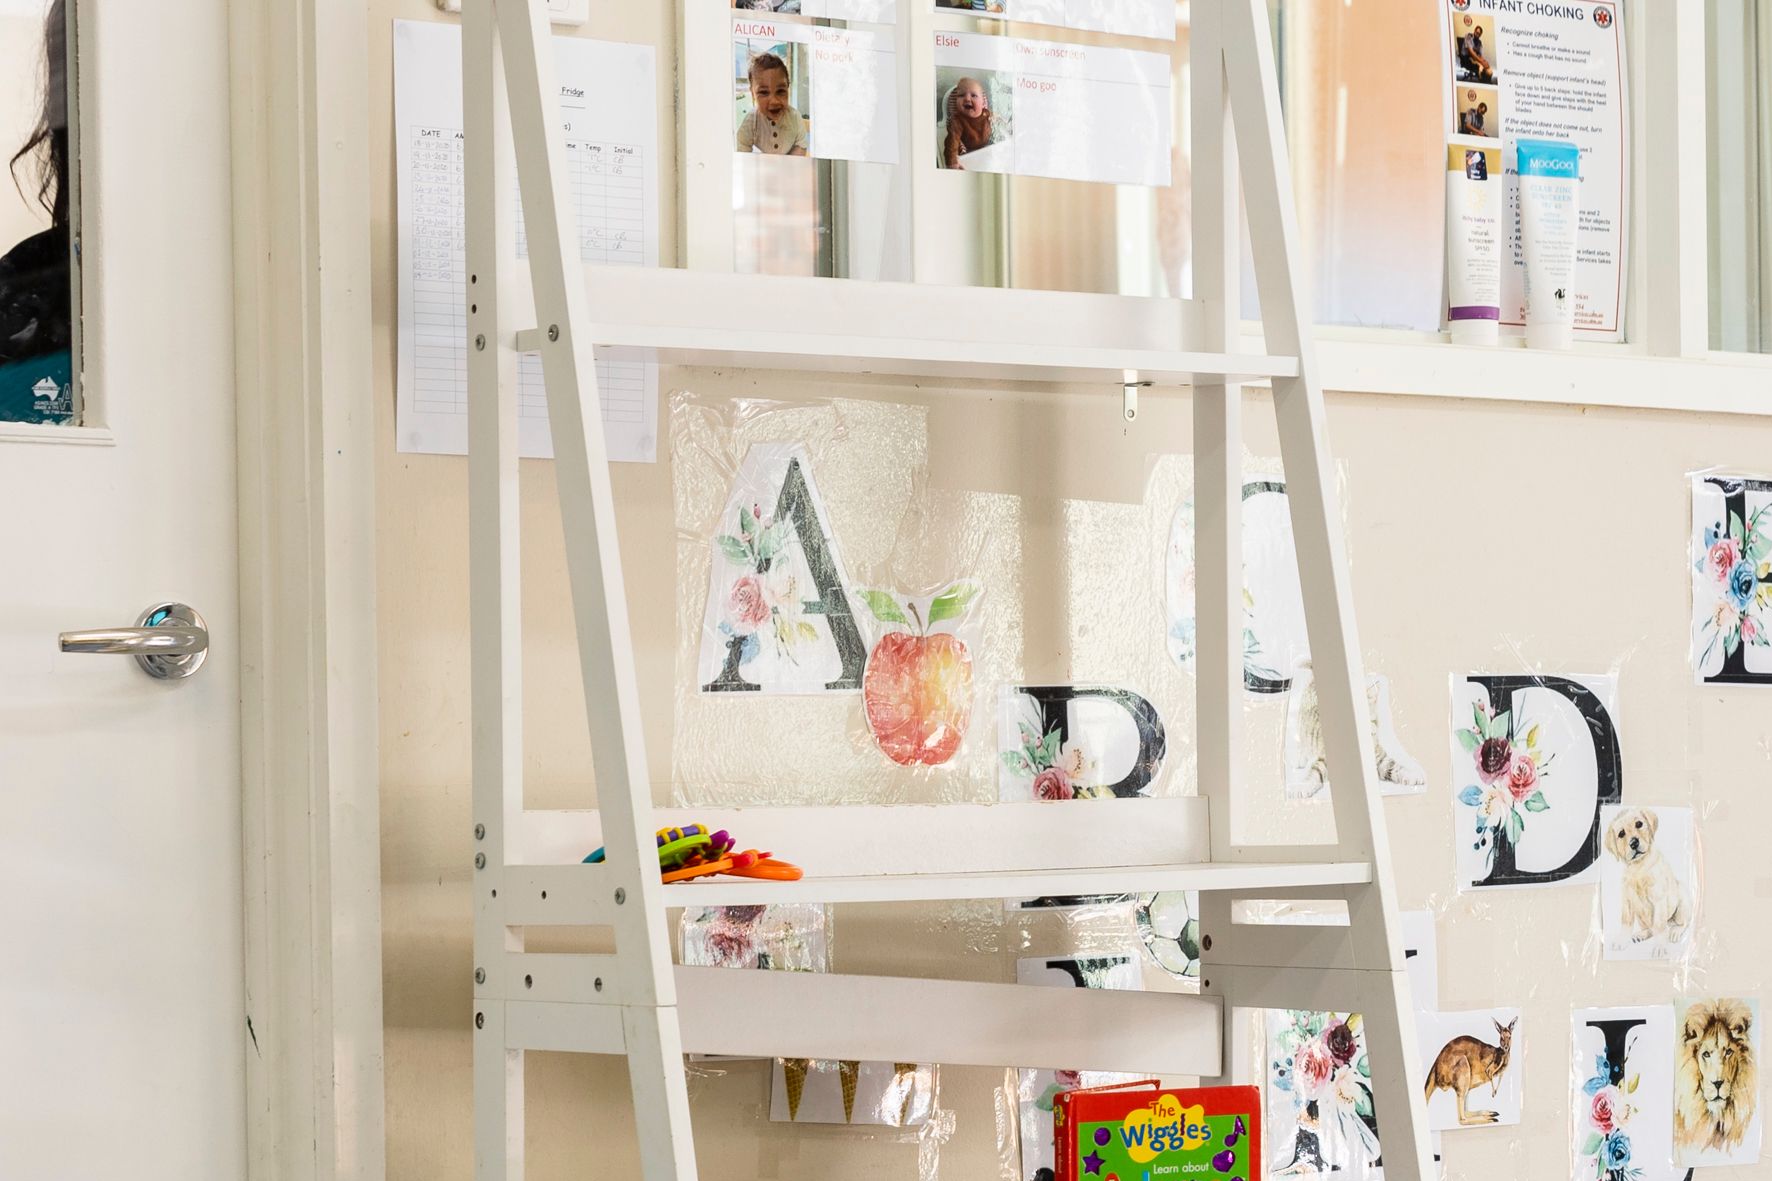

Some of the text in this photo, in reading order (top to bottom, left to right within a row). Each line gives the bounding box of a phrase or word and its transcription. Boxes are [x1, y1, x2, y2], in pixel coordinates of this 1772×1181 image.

[1480, 0, 1584, 20] INFANT CHOKING
[734, 23, 775, 37] ALICAN
[1501, 26, 1559, 41] Recognize choking
[936, 35, 960, 47] Elsie
[561, 85, 585, 98] Fridge
[1040, 80, 1057, 92] goo
[421, 130, 441, 138] DATE
[585, 143, 601, 152] Temp
[614, 146, 633, 155] Initial
[702, 456, 867, 691] A
[1467, 676, 1623, 887] D
[1150, 1101, 1175, 1118] The
[1119, 1113, 1212, 1152] Wiggles
[1153, 1161, 1209, 1175] Learn about
